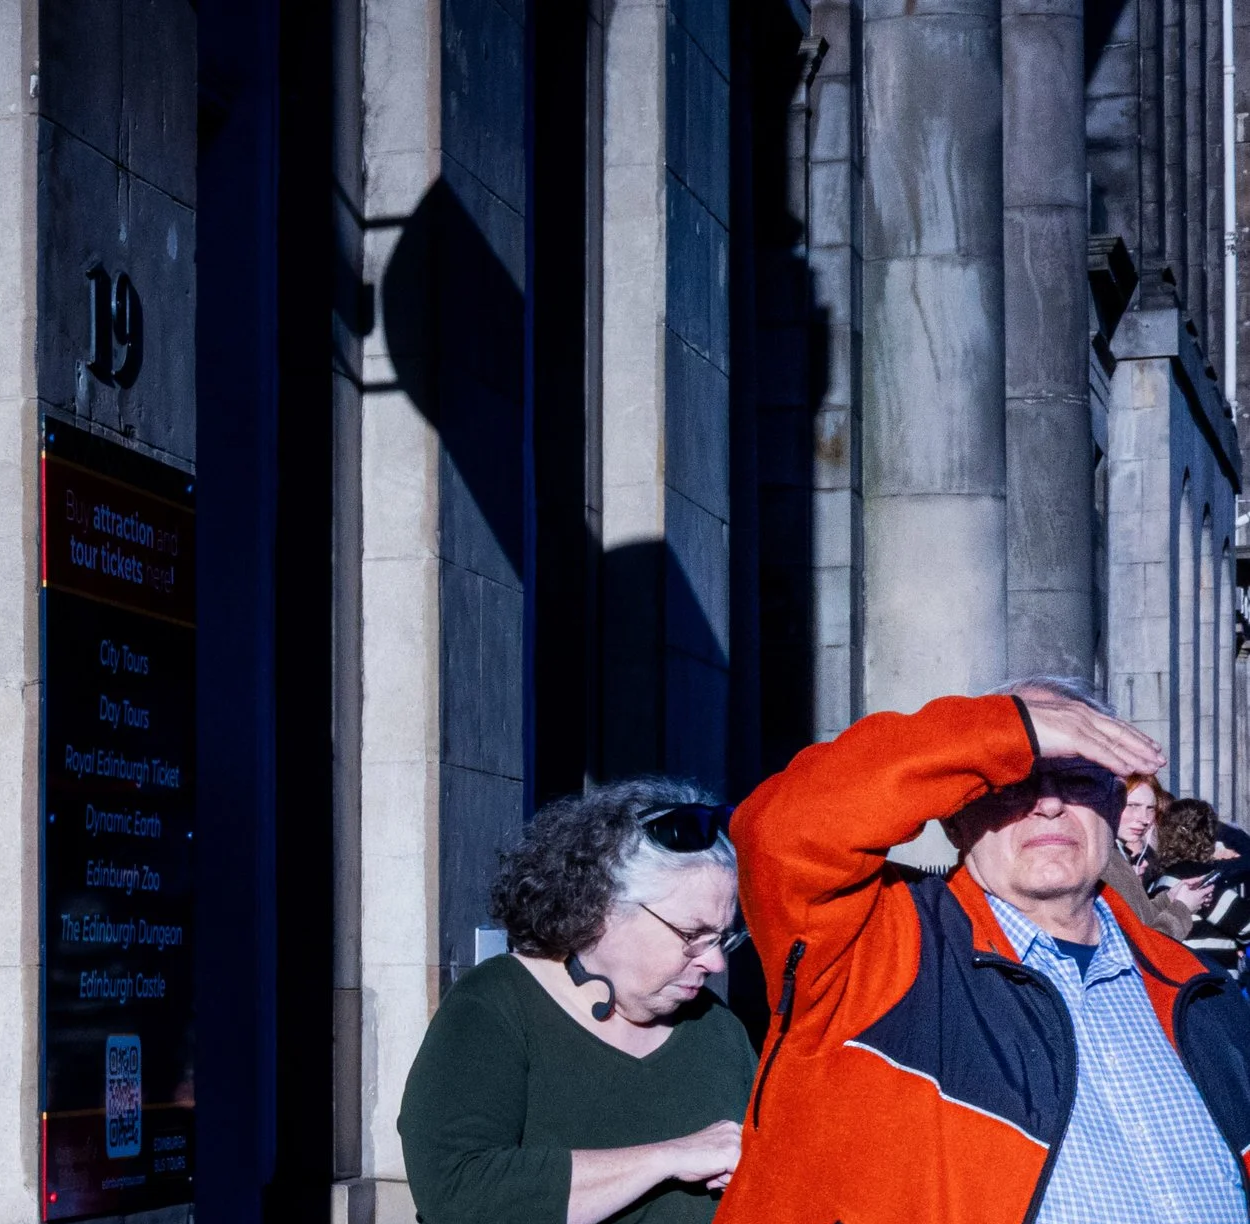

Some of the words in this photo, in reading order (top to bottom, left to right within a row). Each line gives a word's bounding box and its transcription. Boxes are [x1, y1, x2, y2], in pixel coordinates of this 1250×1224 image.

[85, 262, 143, 389] 19
[66, 489, 91, 534] Buy
[93, 503, 154, 549] attraction
[69, 534, 98, 570] tour
[100, 541, 144, 585] tickets
[100, 638, 120, 675] City
[122, 644, 149, 675] Tours
[100, 695, 121, 730] Day
[123, 700, 150, 730] Tours
[65, 744, 95, 779] Royal
[97, 750, 150, 789] Edinburgh
[152, 757, 182, 788] Ticket
[85, 803, 132, 837] Dynamic
[134, 811, 162, 840] Earth
[86, 859, 140, 896] Edinburgh
[142, 865, 161, 892] Zoo
[61, 913, 80, 940] The
[82, 914, 135, 950] Edinburgh
[138, 919, 183, 951] Dungeon
[80, 971, 134, 1004] Edinburgh
[136, 972, 166, 999] Castle
